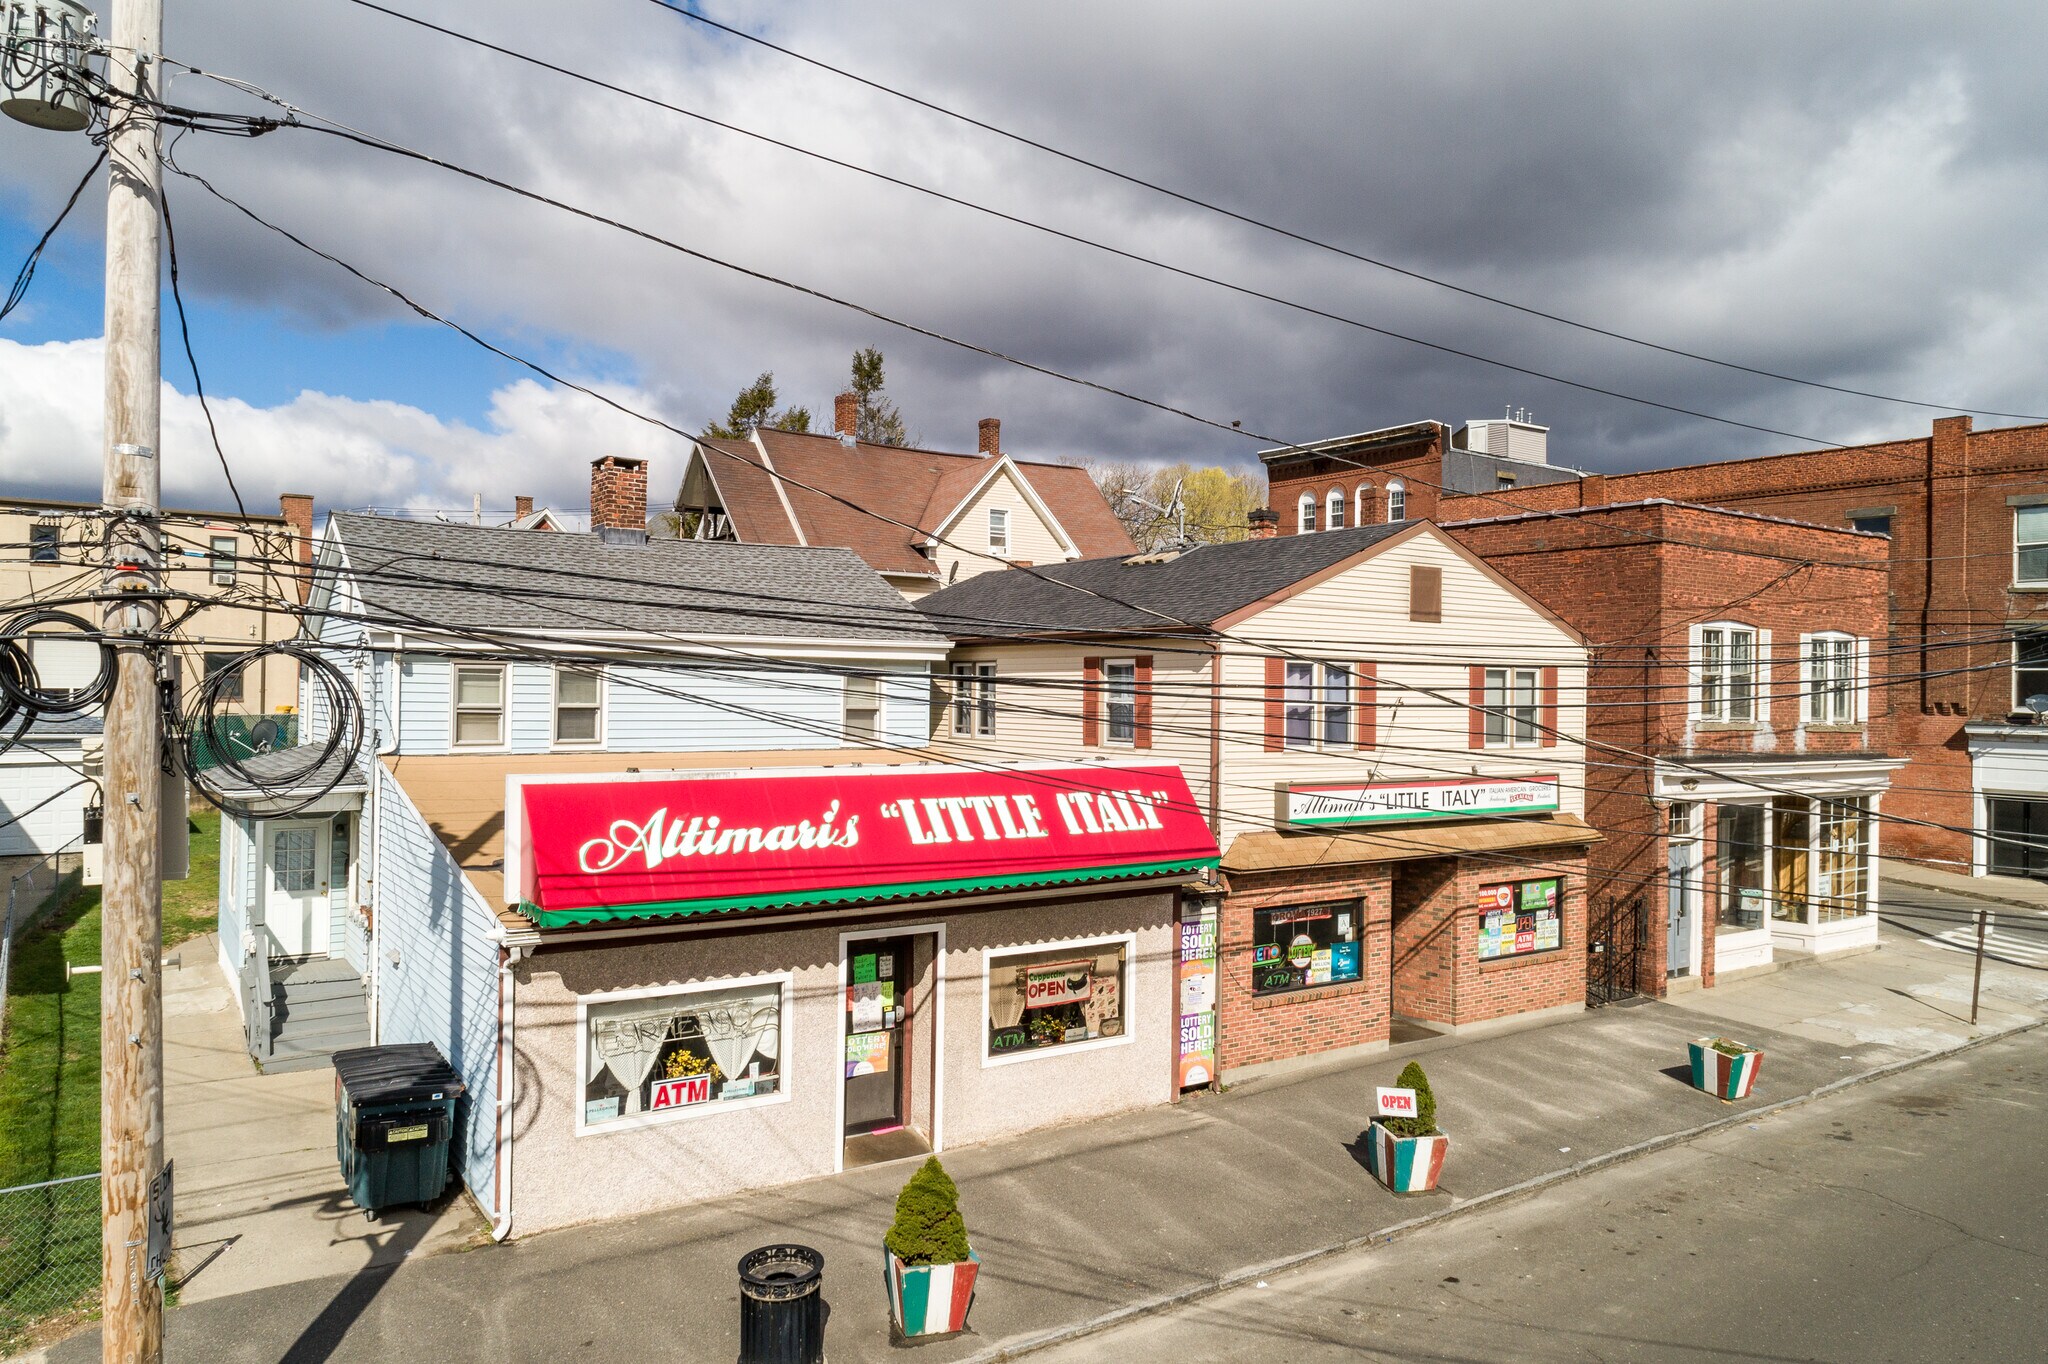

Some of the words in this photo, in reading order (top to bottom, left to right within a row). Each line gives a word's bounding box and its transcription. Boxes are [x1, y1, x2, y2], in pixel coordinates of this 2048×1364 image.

[579, 799, 859, 873] Altimari's
[1182, 923, 1213, 935] LOTTERY
[1182, 934, 1213, 949] SOLD
[1517, 934, 1533, 943] ATM
[1182, 948, 1214, 962] HERE!
[1029, 969, 1066, 982] Cappuccino
[1264, 972, 1290, 987] ATM
[1029, 980, 1066, 998] OPEN
[1181, 1015, 1212, 1028] LOTTERY
[992, 1032, 1025, 1049] ATM
[1181, 1025, 1212, 1042] SOLD
[1181, 1039, 1212, 1054] HERE!
[654, 1079, 709, 1109] ATM
[1381, 1095, 1411, 1110] OPEN
